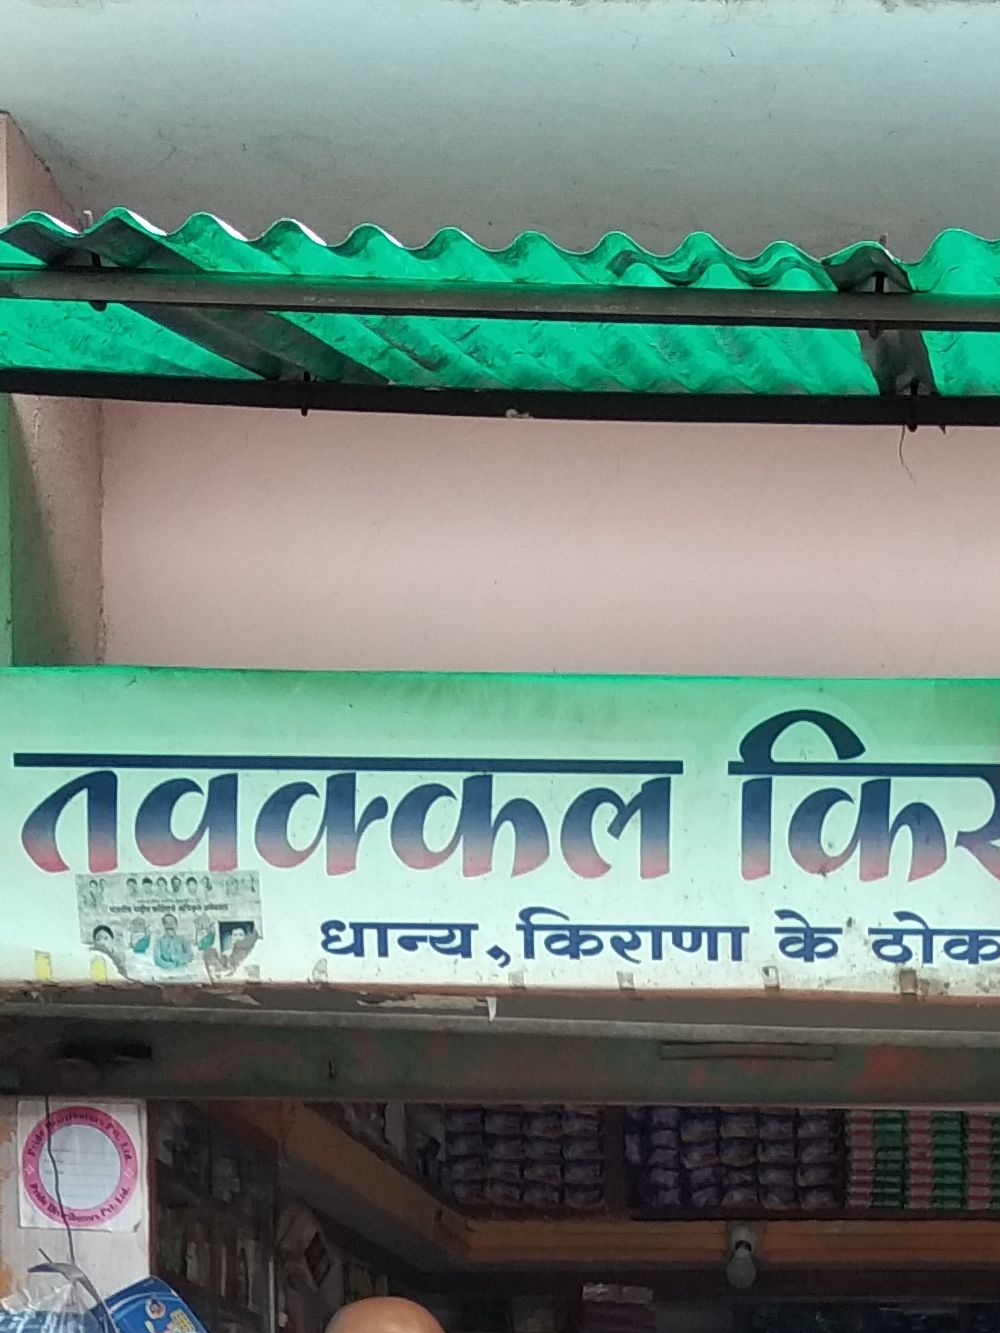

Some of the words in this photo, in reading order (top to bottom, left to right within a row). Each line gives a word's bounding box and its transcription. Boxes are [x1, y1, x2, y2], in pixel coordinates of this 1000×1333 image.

[14, 752, 683, 880] तवक्कल
[515, 905, 750, 964] किराणा
[774, 908, 842, 963] के
